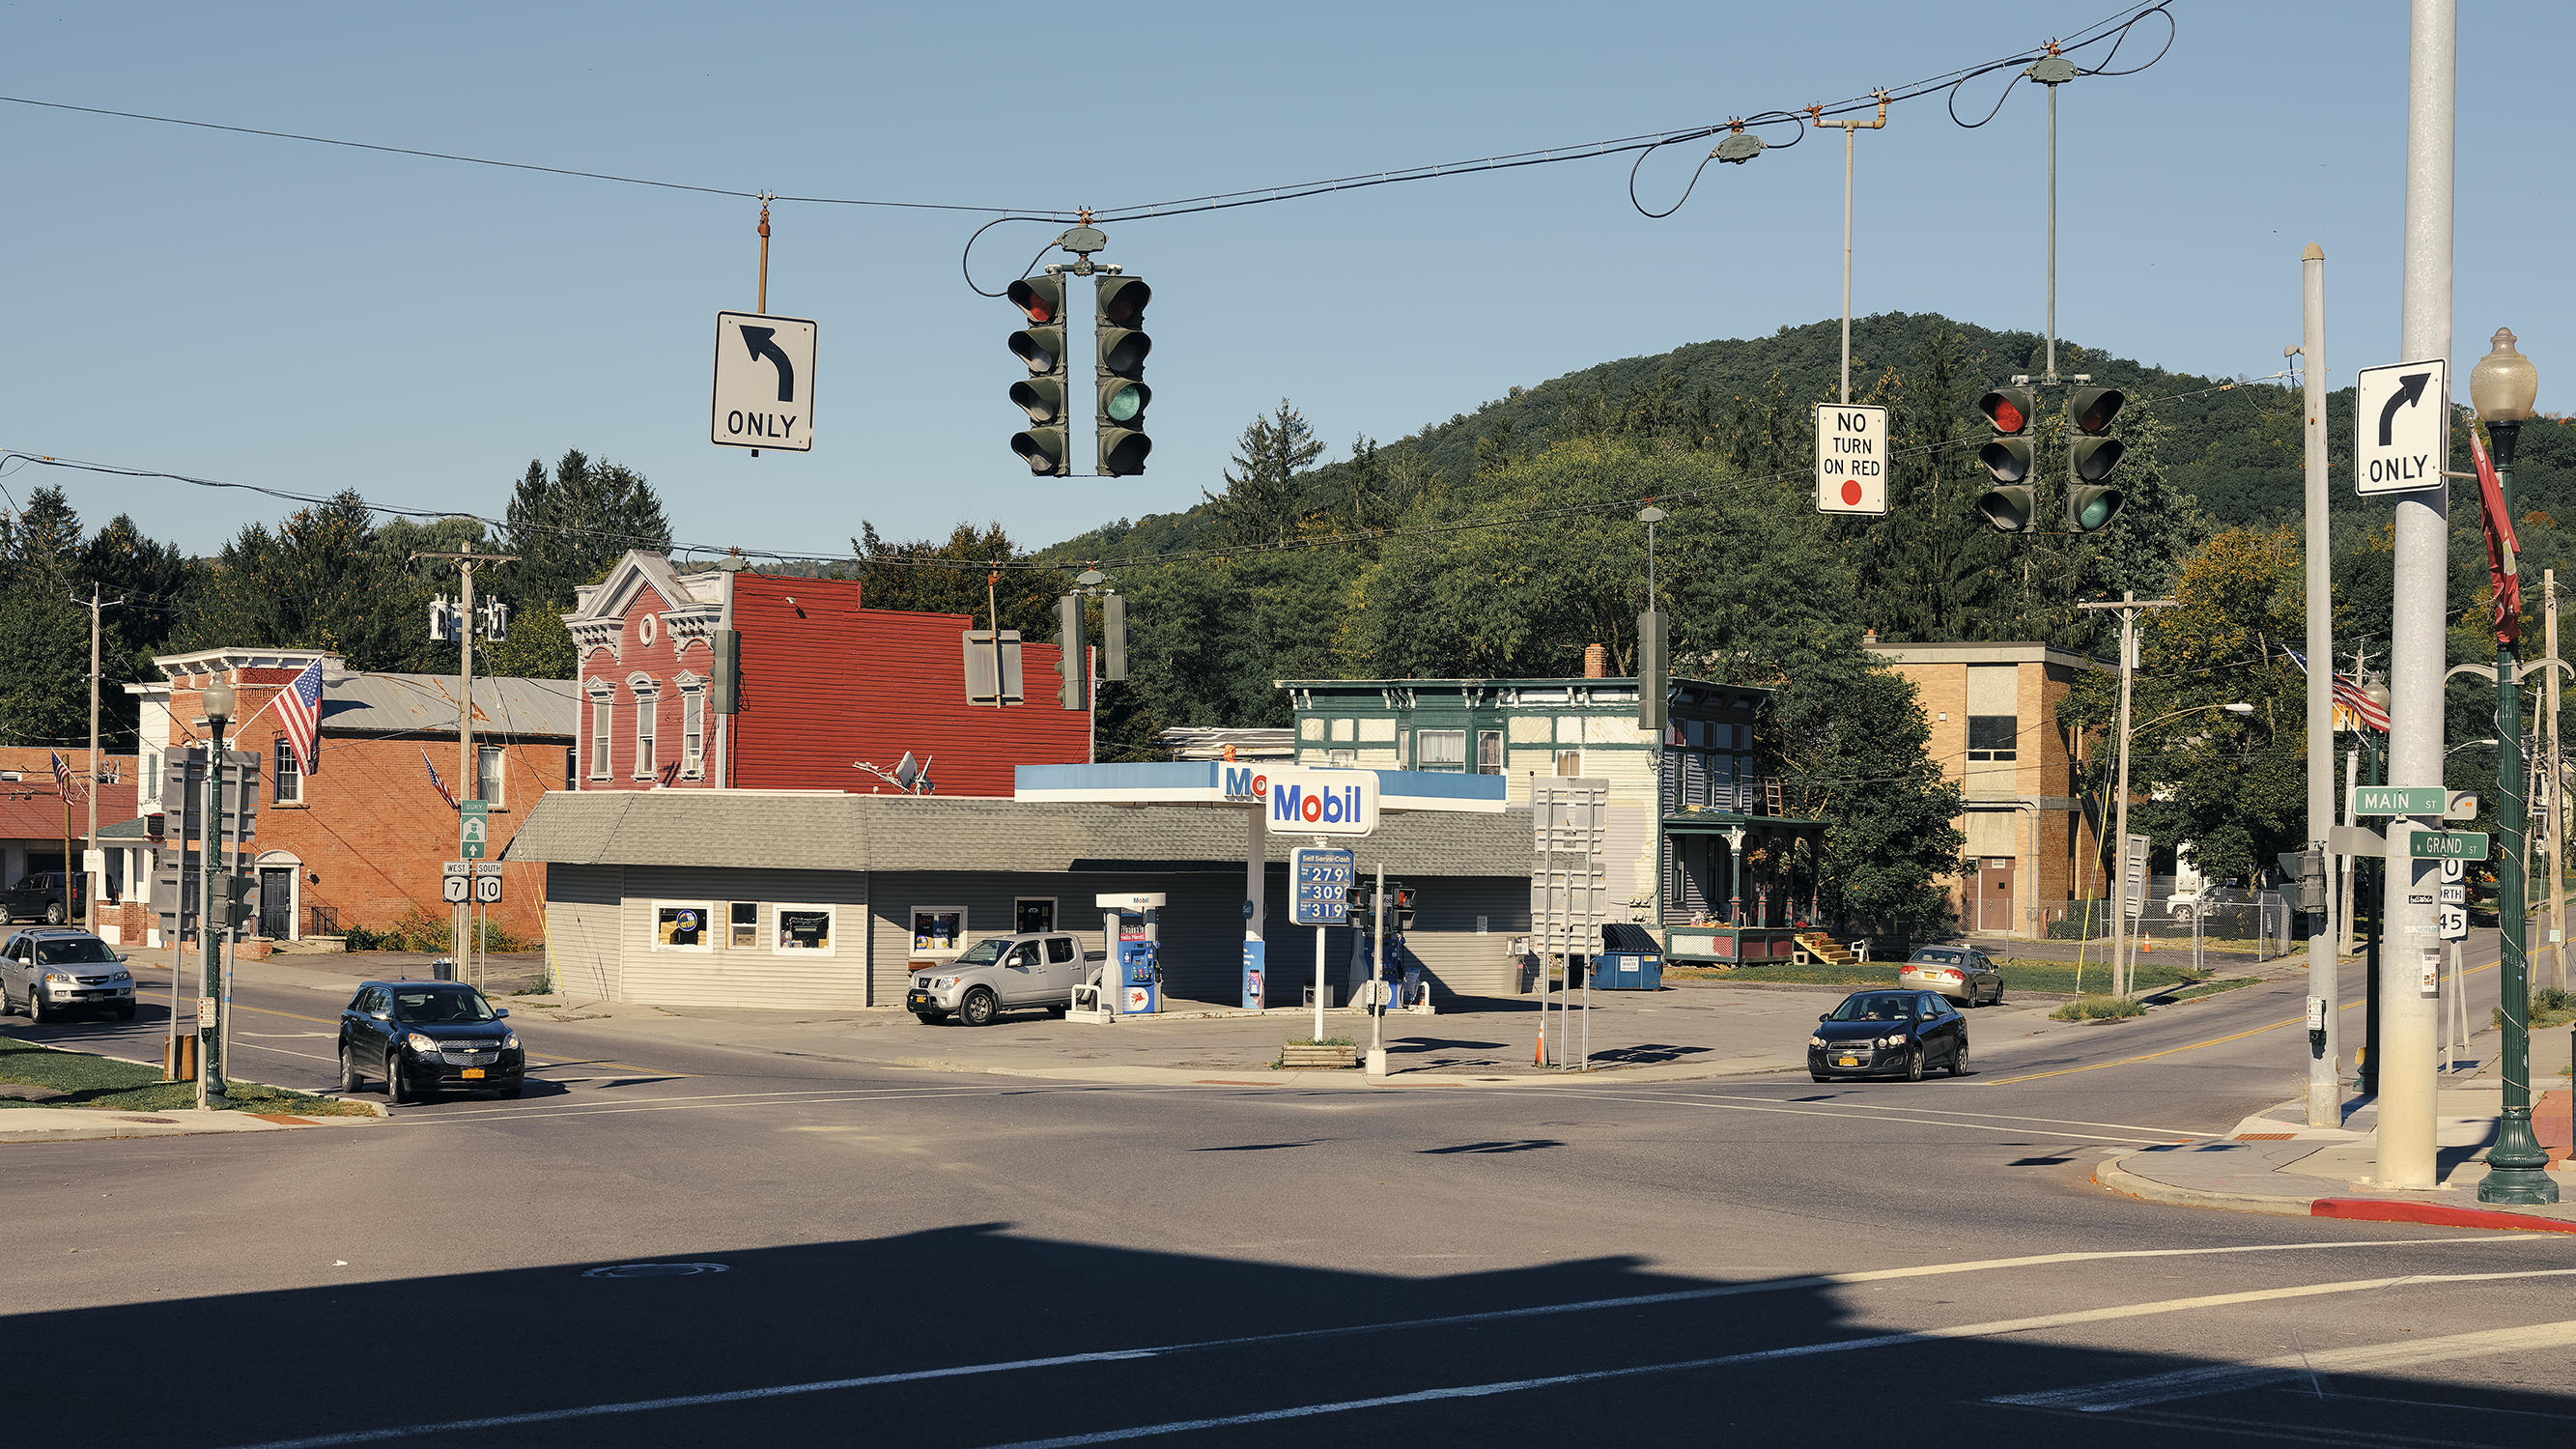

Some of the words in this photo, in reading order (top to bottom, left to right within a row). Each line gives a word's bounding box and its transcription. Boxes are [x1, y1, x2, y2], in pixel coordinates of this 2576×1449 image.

[727, 410, 797, 439] ONLY
[1837, 412, 1866, 433] NO
[1832, 437, 1872, 454] TURN
[1824, 458, 1844, 474] ON
[1852, 460, 1881, 476] RED
[2369, 454, 2428, 483] ONLY
[1274, 784, 1361, 823] Mobil
[2364, 792, 2410, 810] MAIN
[2425, 800, 2437, 810] ST
[2416, 843, 2421, 853] N
[2426, 837, 2462, 854] GRAND
[2469, 845, 2477, 854] ST
[446, 864, 467, 872] WEST
[478, 864, 501, 873] SOUTH
[2445, 859, 2459, 877] 0
[451, 881, 462, 896] 7
[480, 881, 498, 897] 10
[2440, 889, 2462, 899] RTH
[2440, 913, 2462, 930] 45
